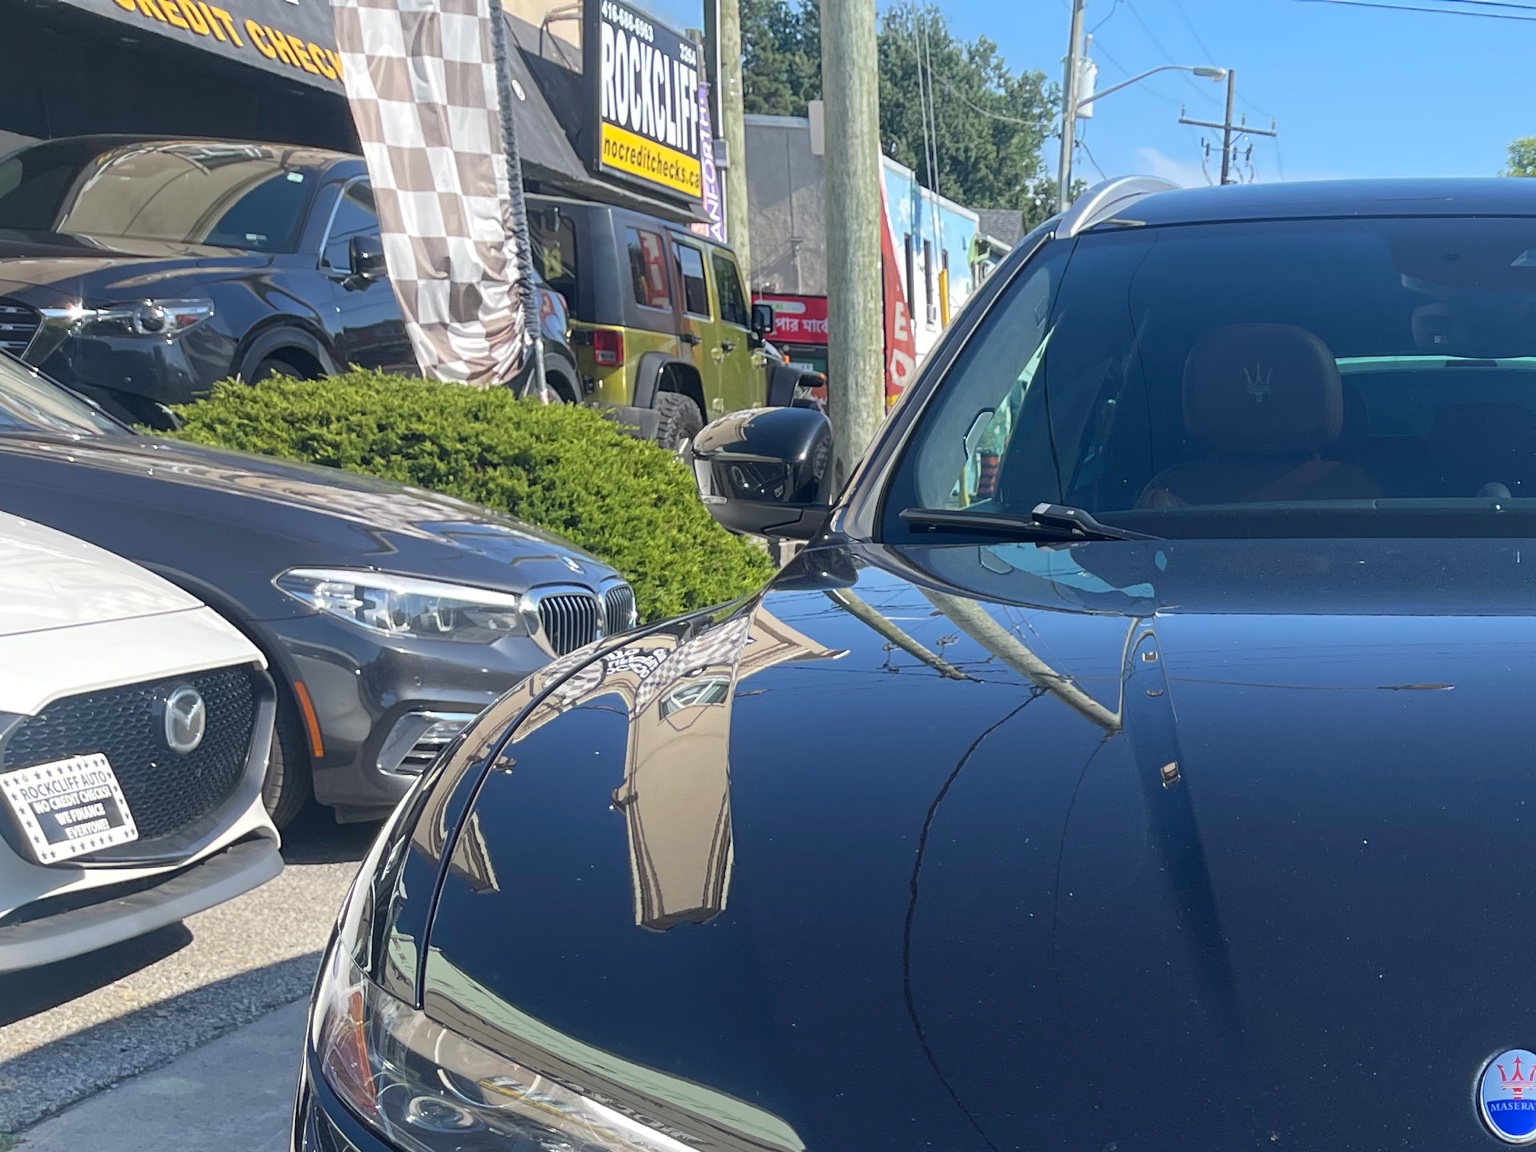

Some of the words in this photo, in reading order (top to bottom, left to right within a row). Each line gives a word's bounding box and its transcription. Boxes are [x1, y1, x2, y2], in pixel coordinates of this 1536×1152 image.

[114, 0, 243, 48] EDIT
[601, 21, 699, 155] ROCKCLIFF
[603, 136, 700, 189] nocreditchecks.ca
[20, 776, 80, 801] ROCKCLIFF
[80, 770, 108, 788] AUTO
[33, 799, 52, 815] NO
[49, 792, 81, 811] CREDIT
[55, 810, 75, 826] WE
[72, 802, 107, 822] FINANCE
